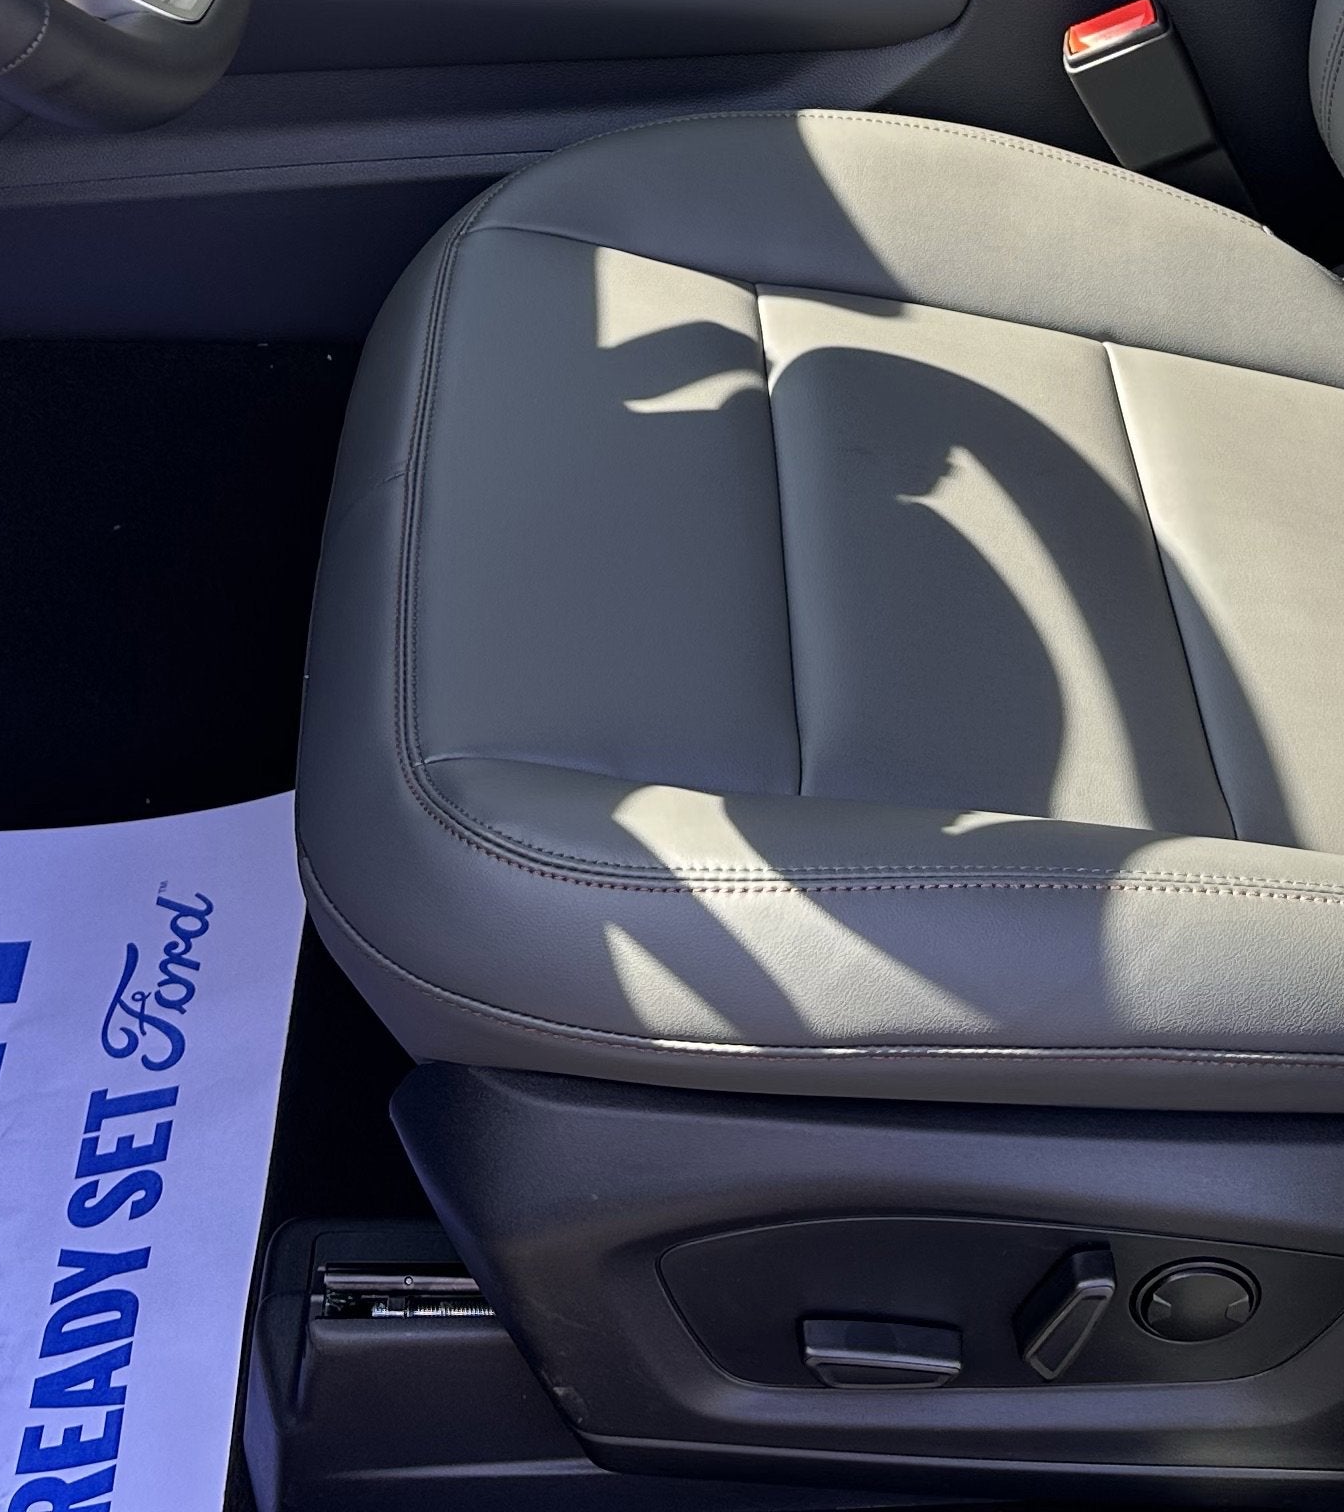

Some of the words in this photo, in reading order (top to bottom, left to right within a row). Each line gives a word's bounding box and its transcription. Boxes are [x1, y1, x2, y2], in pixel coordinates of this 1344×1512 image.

[101, 891, 215, 1072] Ford
[67, 1085, 180, 1230] SET
[7, 1244, 152, 1512] READY
